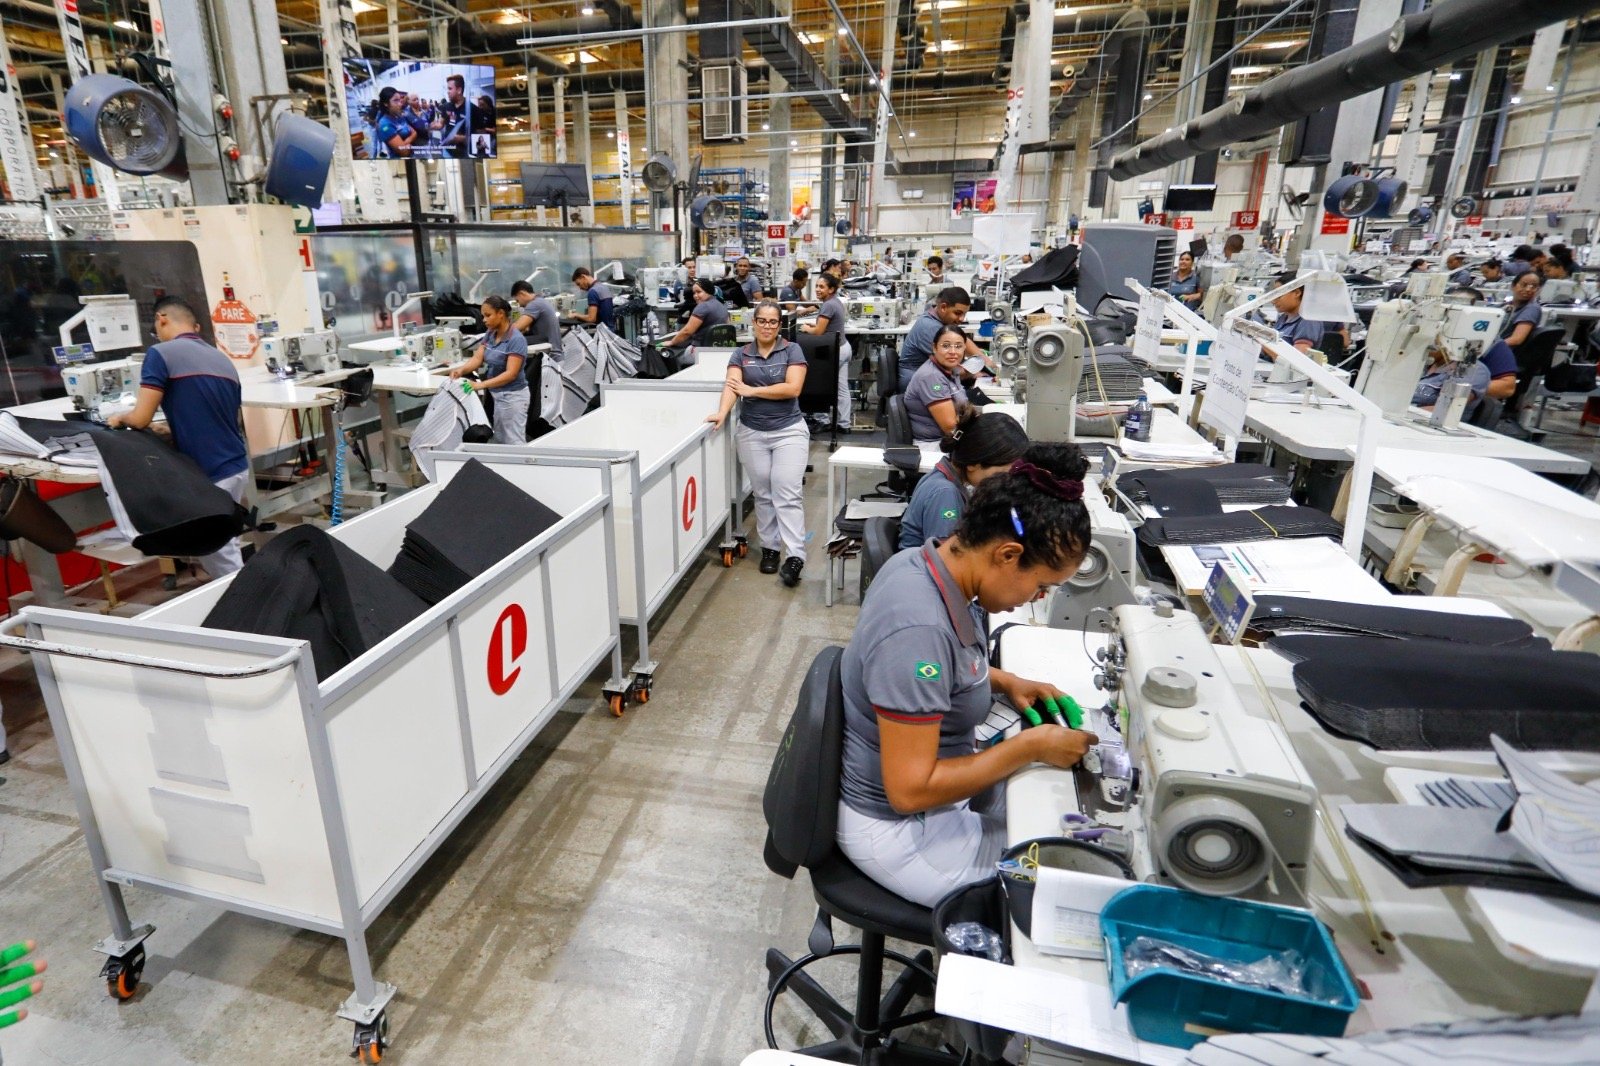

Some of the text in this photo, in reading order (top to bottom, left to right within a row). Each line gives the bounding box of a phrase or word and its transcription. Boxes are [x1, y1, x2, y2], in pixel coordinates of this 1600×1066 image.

[621, 142, 630, 179] LEAR
[1240, 215, 1254, 224] 08
[220, 307, 246, 320] PARE
